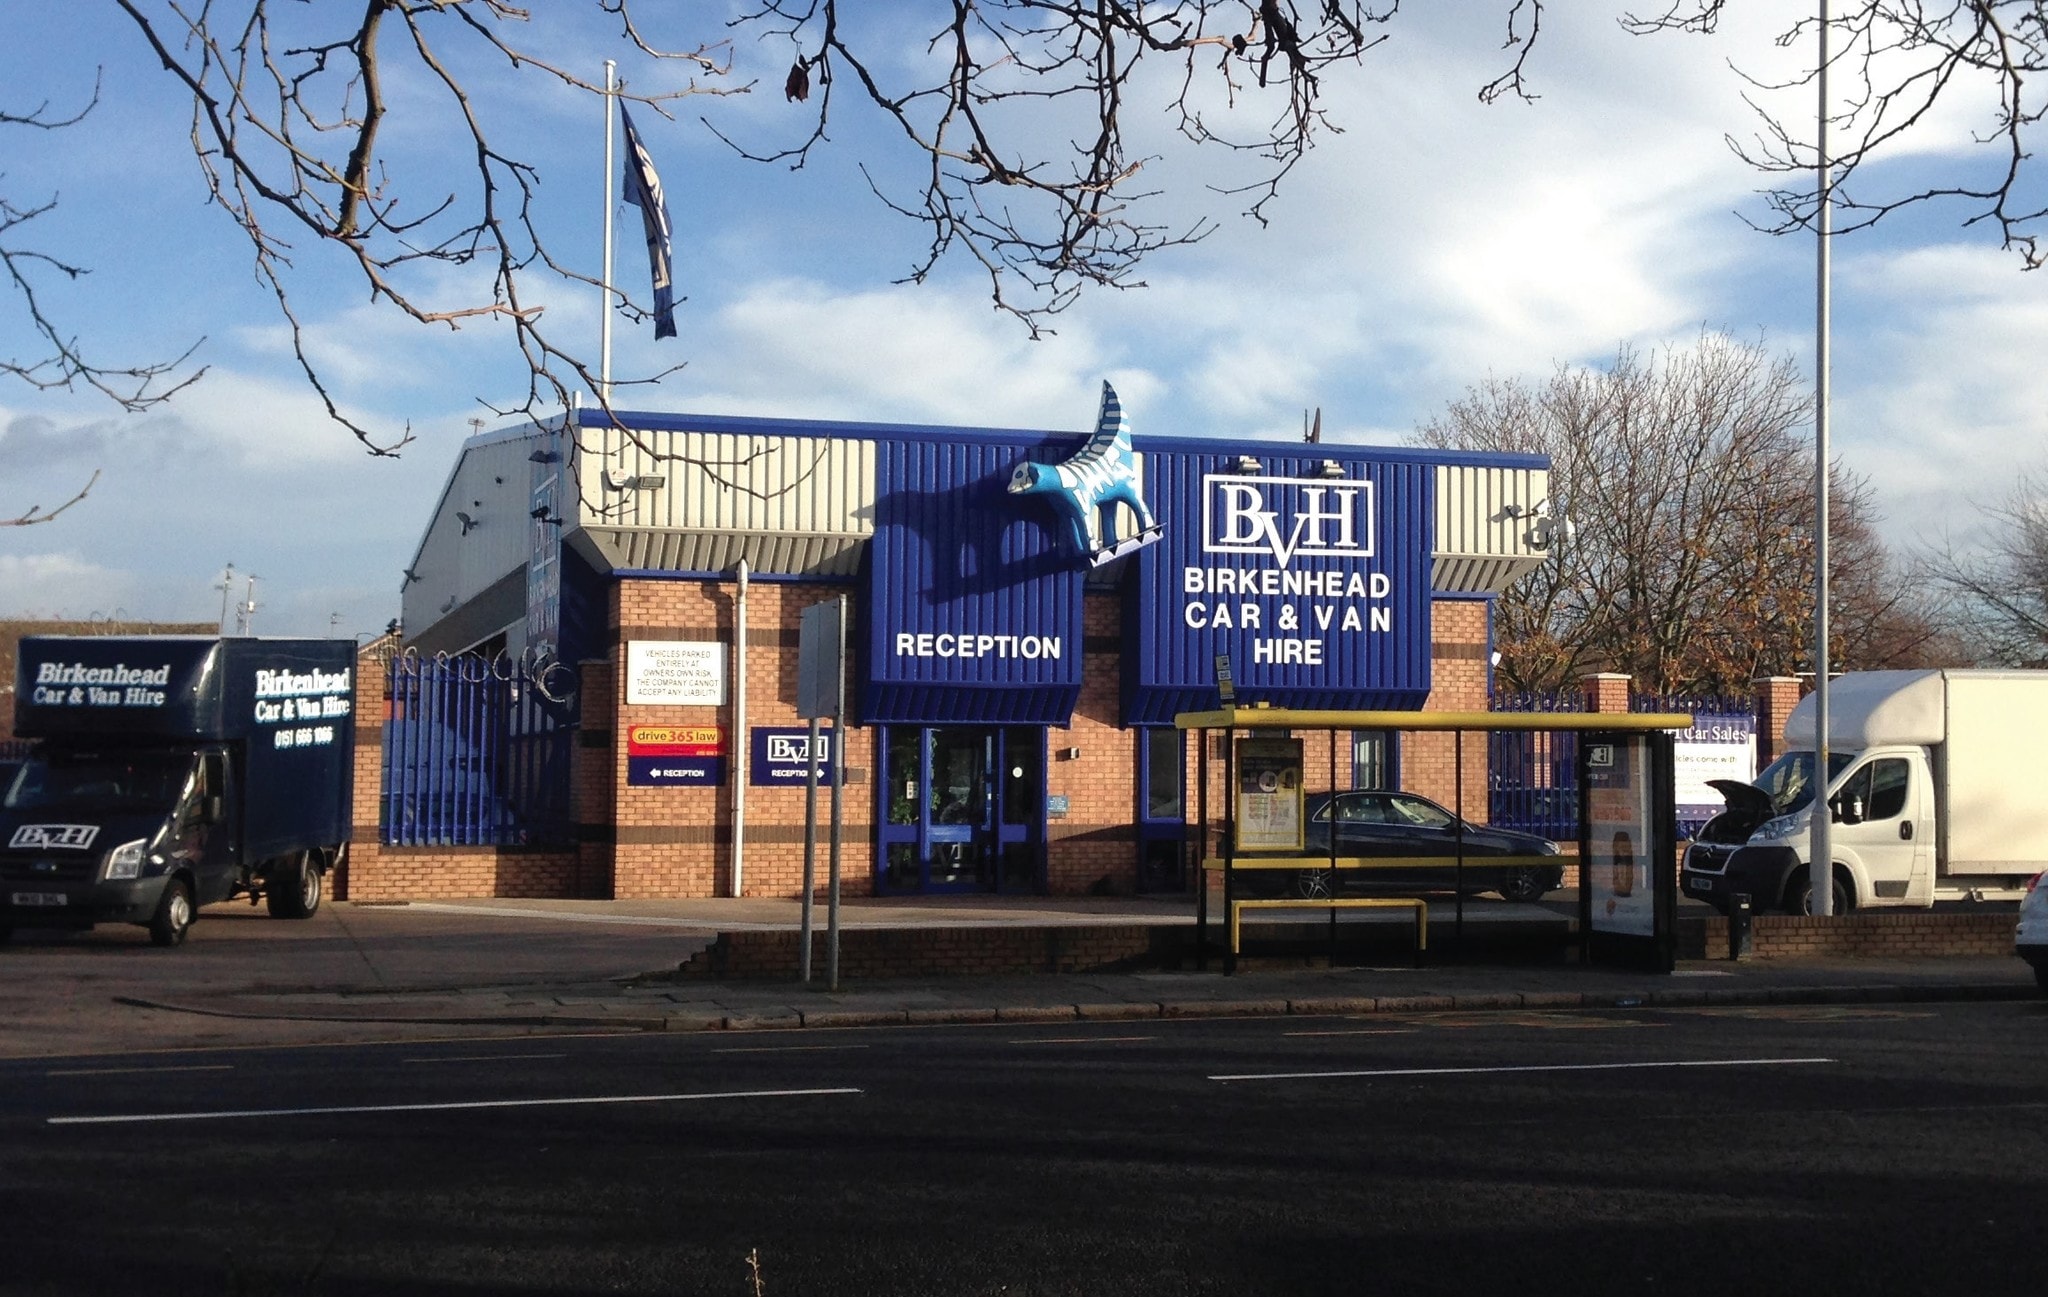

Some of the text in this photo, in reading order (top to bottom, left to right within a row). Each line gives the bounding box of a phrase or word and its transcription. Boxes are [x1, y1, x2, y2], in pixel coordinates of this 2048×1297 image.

[1219, 484, 1359, 569] BVH
[1184, 567, 1390, 599] BIRKENHEAD
[1185, 602, 1390, 632] CAR & VAN
[645, 650, 680, 658] VEHICLES
[896, 633, 1061, 660] RECEPTION
[1254, 639, 1322, 665] HIRE
[656, 659, 689, 667] ENTIRELY
[36, 662, 171, 686] Birkenhead
[255, 668, 350, 697] Birkenhead
[643, 669, 675, 677] OWNERS
[696, 669, 712, 678] RISK
[689, 679, 719, 687] CANNOT
[33, 686, 166, 706] Car & Van Hire
[638, 688, 666, 696] ACCEPT
[684, 689, 717, 697] LIABILITY
[255, 696, 350, 722] Car & Van Hire
[274, 730, 294, 748] 0151
[638, 731, 716, 742] drive 365 law
[1684, 725, 1708, 740] Car
[1712, 726, 1747, 741] Sales
[663, 769, 704, 777] RECEPTION
